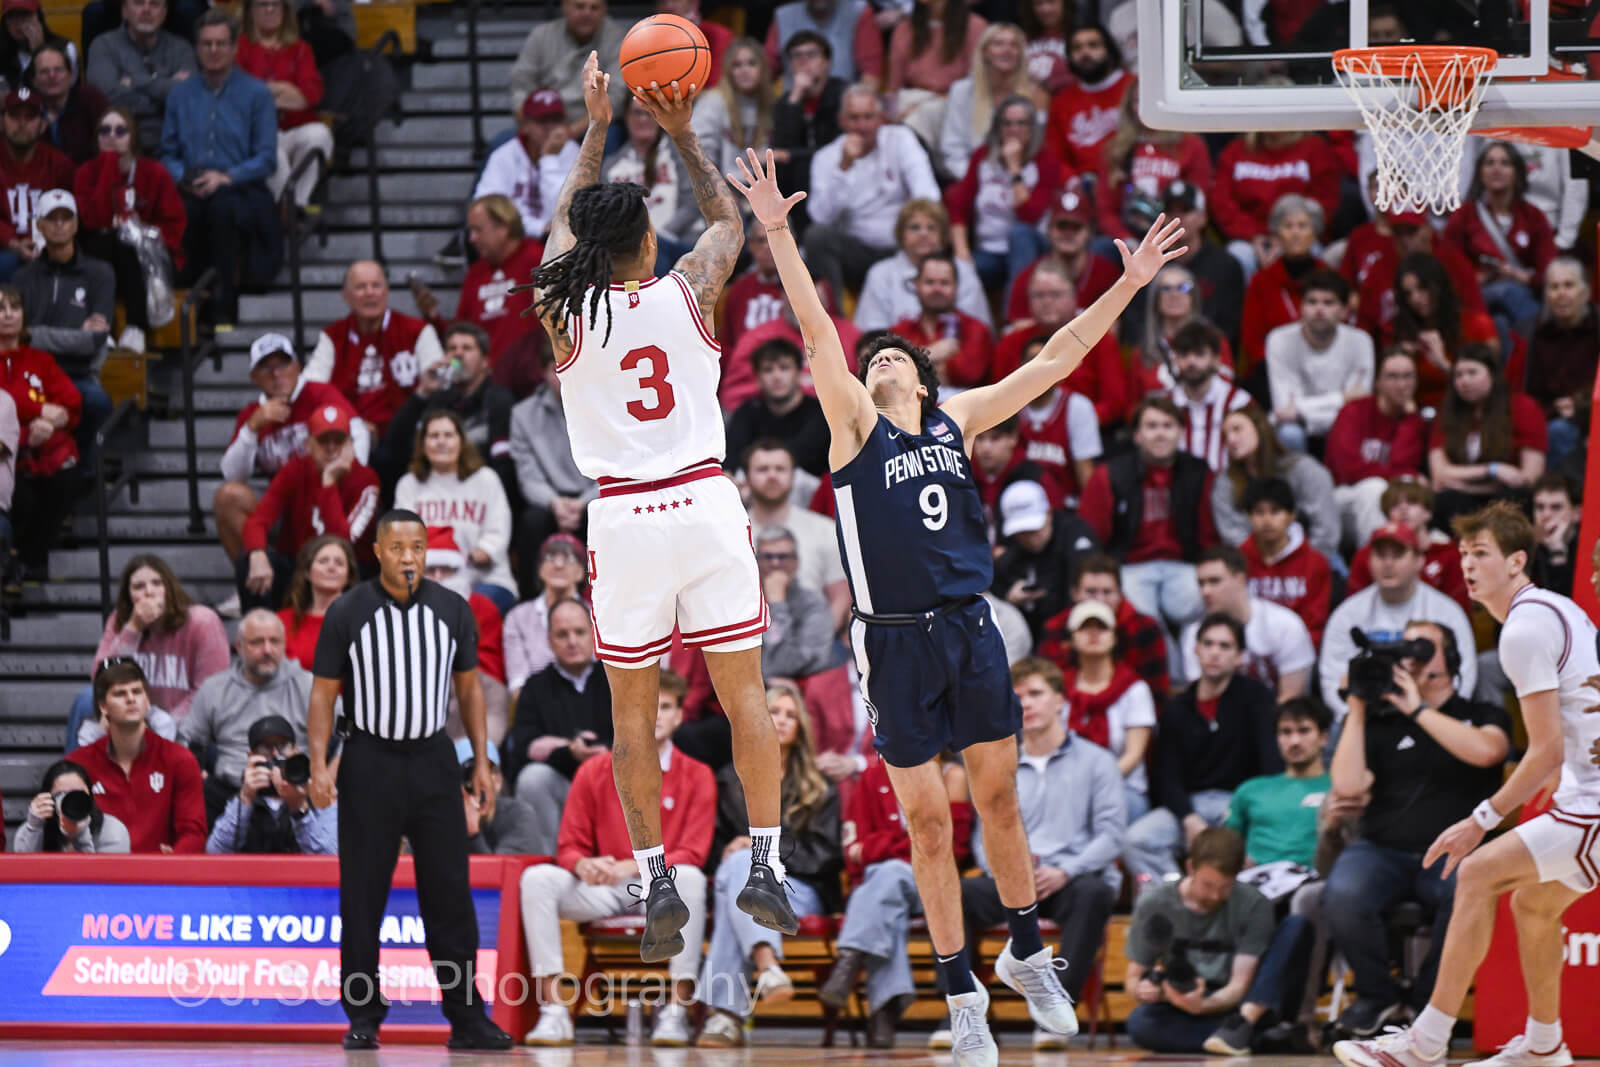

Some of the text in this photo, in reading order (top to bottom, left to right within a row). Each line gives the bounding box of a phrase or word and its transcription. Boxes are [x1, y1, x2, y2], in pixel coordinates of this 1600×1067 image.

[620, 345, 676, 422] 3
[884, 444, 966, 490] PENN STATE
[919, 483, 948, 531] 9
[82, 914, 427, 944] MOVE LIKE YOU AN
[74, 956, 189, 986] Schedule
[195, 958, 249, 986] Your
[254, 959, 309, 987] Free
